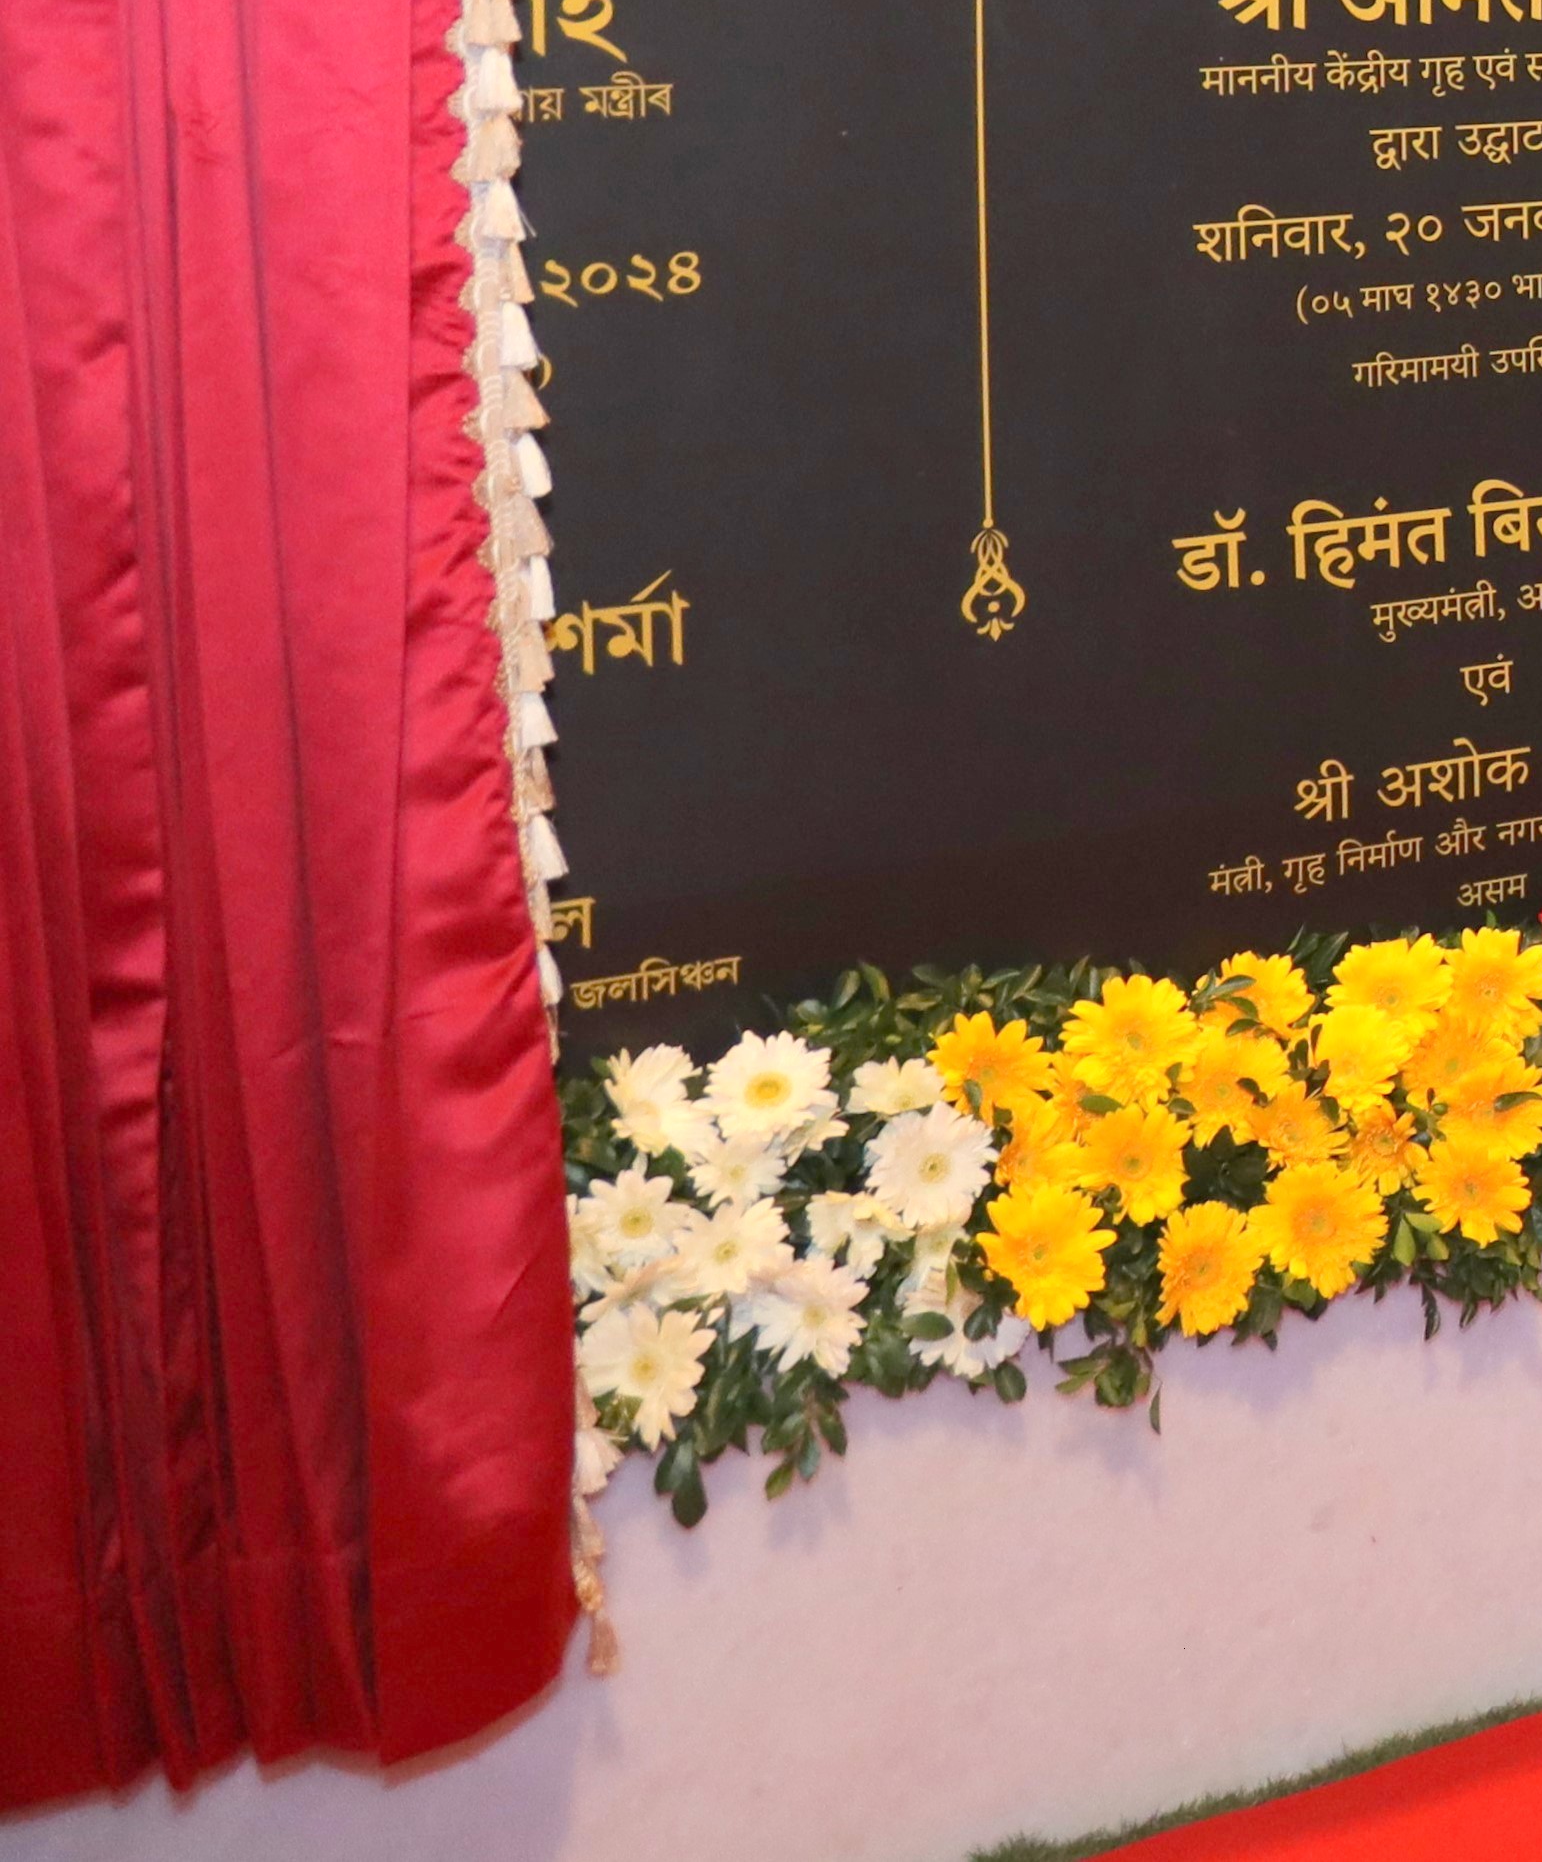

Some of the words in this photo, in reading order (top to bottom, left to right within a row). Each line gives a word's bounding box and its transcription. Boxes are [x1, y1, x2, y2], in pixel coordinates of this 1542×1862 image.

[1199, 52, 1318, 97] माननीय
[1323, 48, 1412, 95] केंद्रीय
[1418, 55, 1467, 98] गृह
[1471, 47, 1519, 91] एवं
[1368, 125, 1444, 171] द्वारा
[1191, 203, 1367, 264] शनिवार,
[1385, 211, 1444, 257] २०
[540, 248, 703, 309] ২০২৪
[1296, 286, 1354, 325] (०५
[1359, 283, 1415, 313] माघ
[1425, 279, 1502, 313] १४३०
[1351, 342, 1481, 388] गरिमामयी
[1171, 507, 1267, 592] डॉ.
[1285, 496, 1456, 594] हिमंत
[1369, 578, 1507, 644] मुख्यमंत्री,
[1459, 653, 1514, 707] एवं
[1293, 758, 1355, 822] श्री
[1376, 736, 1532, 808] अशोक
[1207, 854, 1273, 896] मंत्री,
[1281, 852, 1327, 895] गृह
[1335, 829, 1424, 876] निर्माण
[1434, 817, 1487, 856] और
[1457, 873, 1528, 907] असम
